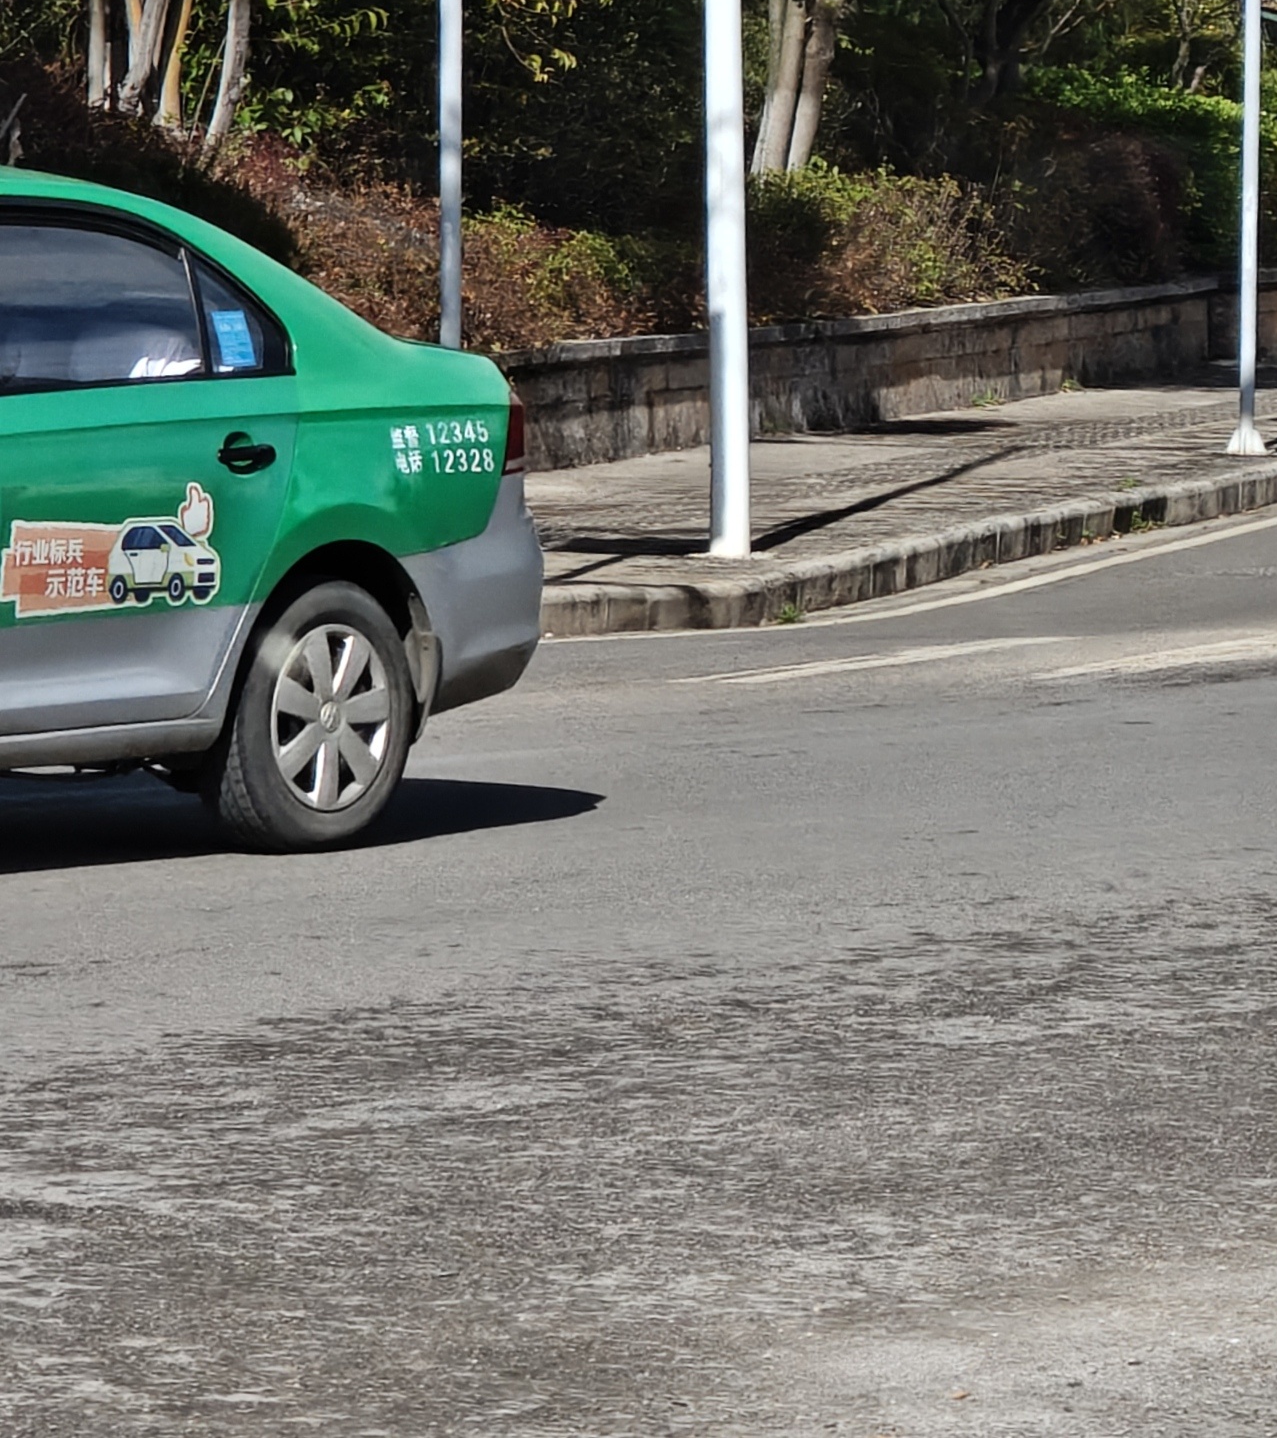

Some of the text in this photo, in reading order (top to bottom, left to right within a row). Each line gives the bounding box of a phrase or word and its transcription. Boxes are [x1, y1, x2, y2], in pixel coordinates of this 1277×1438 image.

[391, 420, 489, 449] 监督 12345
[395, 448, 494, 473] 电话 12328
[14, 539, 84, 567] 行业标兵
[45, 567, 105, 598] 示范车
